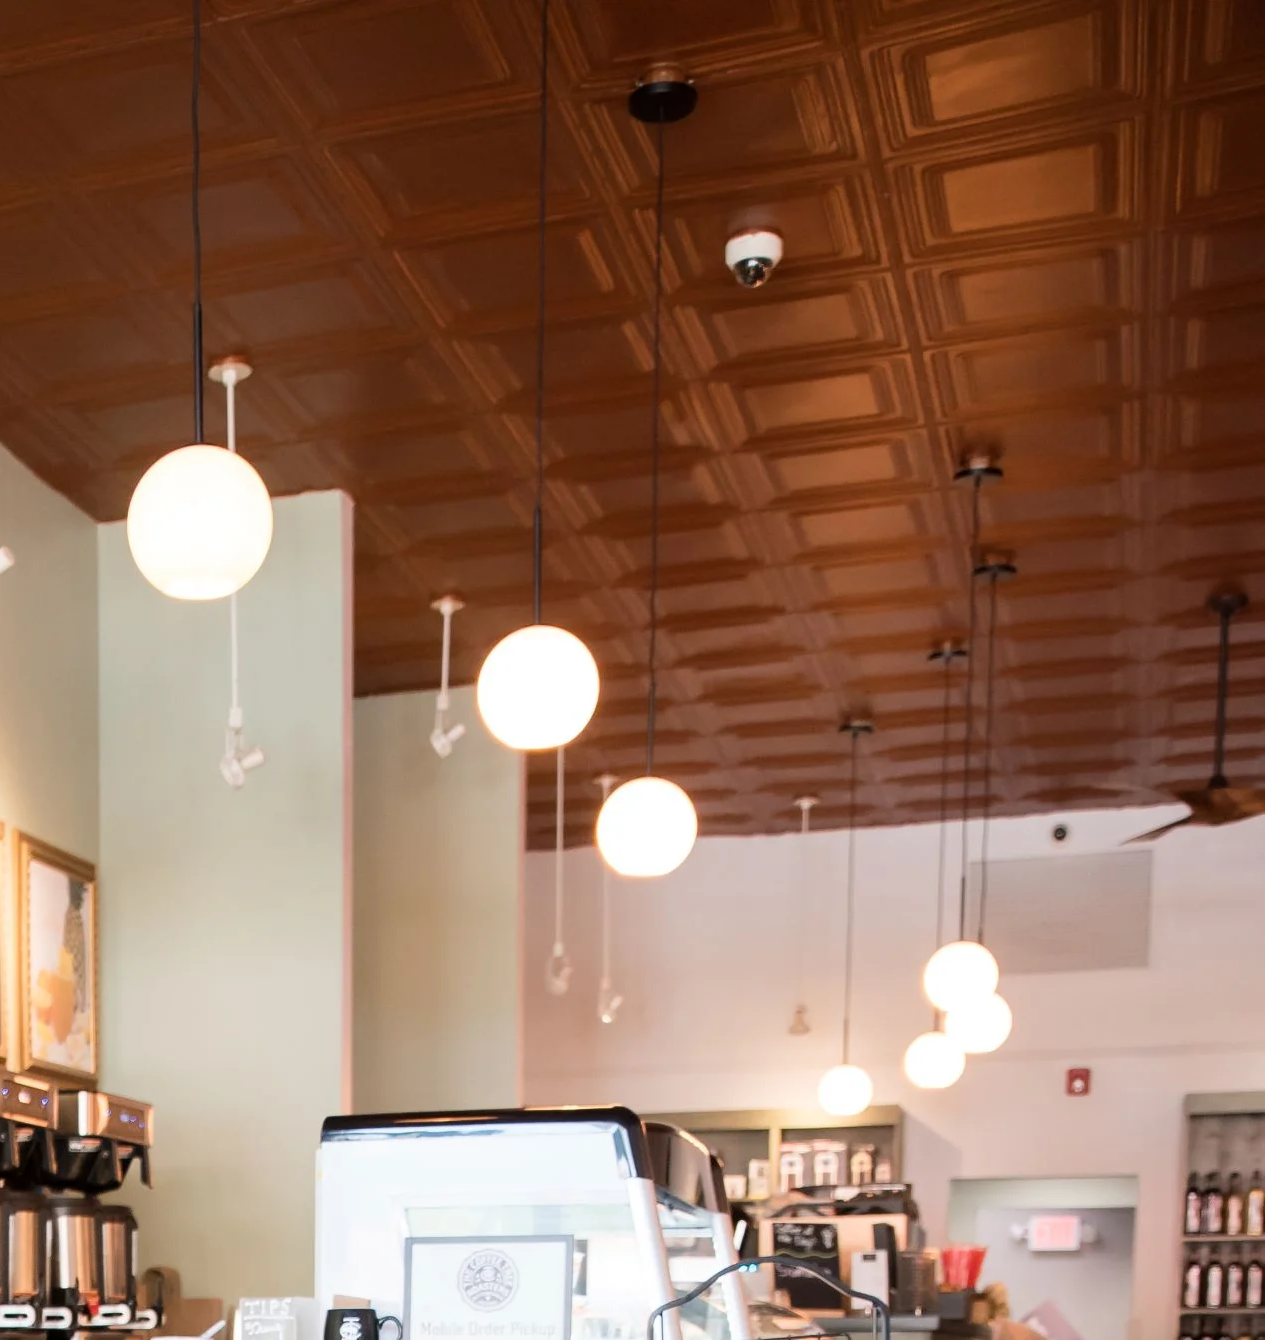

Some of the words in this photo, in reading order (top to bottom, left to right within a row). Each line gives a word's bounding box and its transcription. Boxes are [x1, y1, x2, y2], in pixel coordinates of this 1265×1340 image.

[244, 1299, 292, 1316] TIPS
[420, 1320, 464, 1336] Mobile
[467, 1320, 506, 1336] Order
[510, 1321, 557, 1340] Pickup
